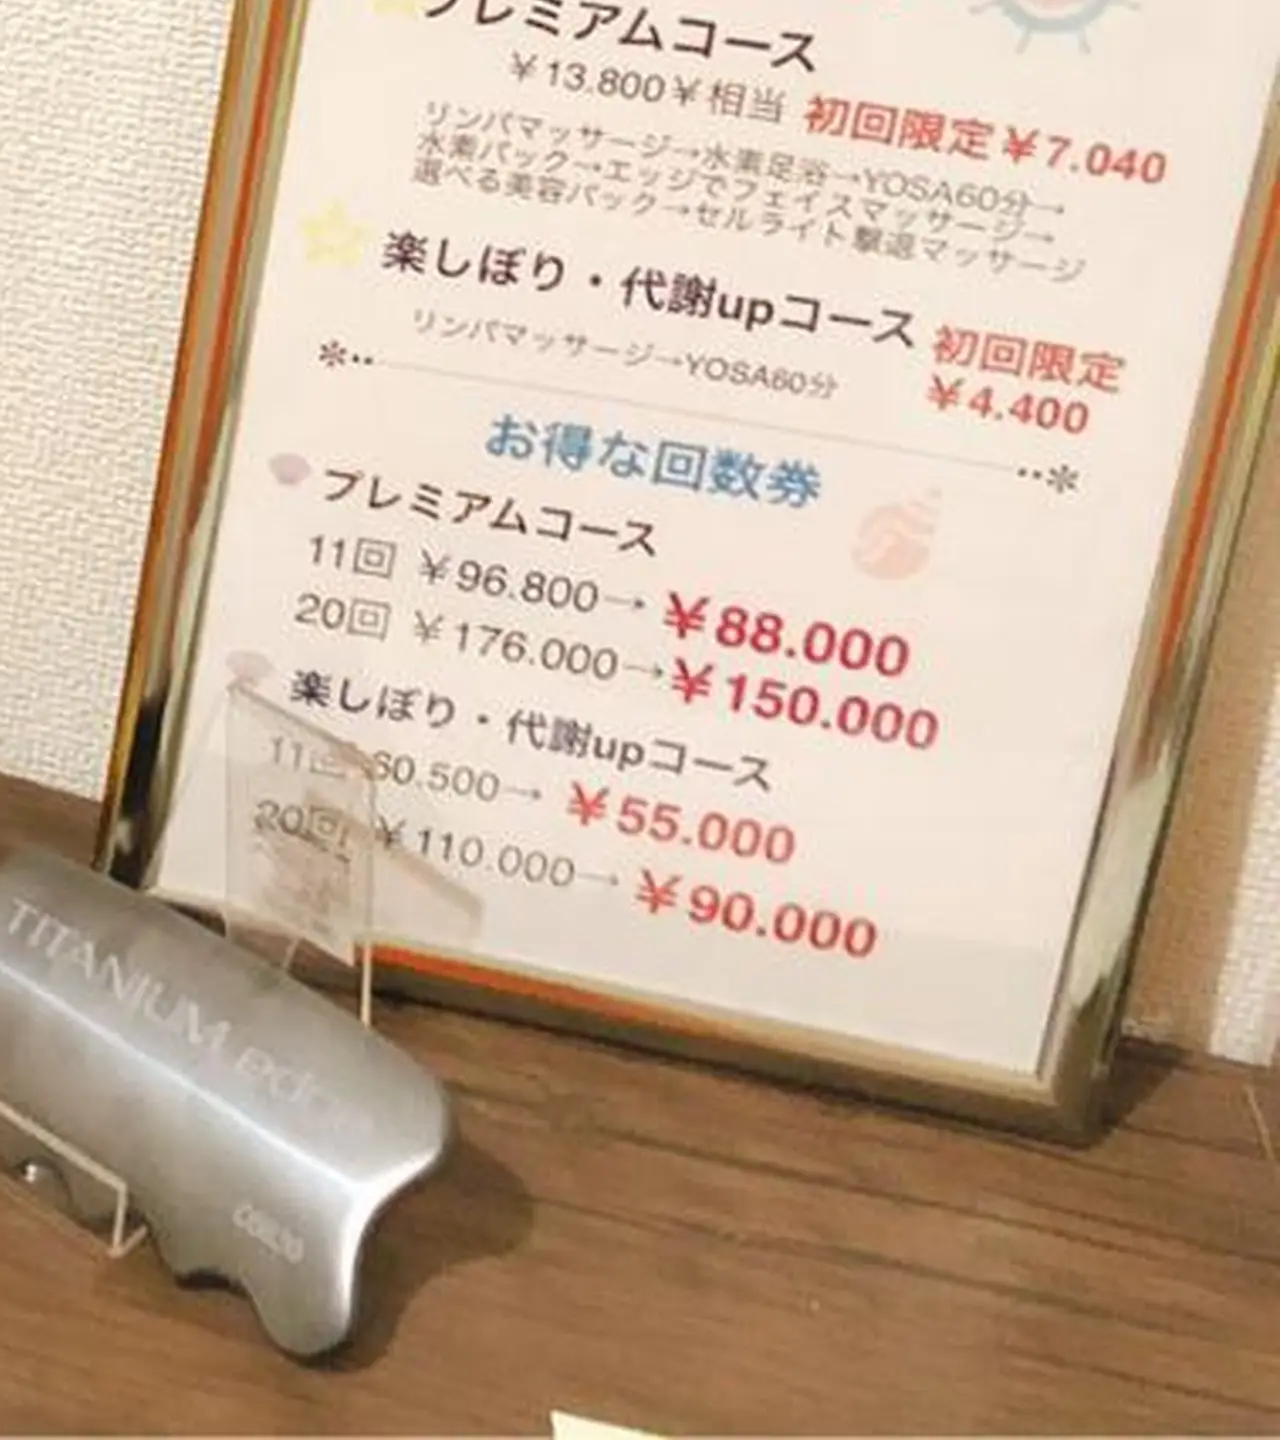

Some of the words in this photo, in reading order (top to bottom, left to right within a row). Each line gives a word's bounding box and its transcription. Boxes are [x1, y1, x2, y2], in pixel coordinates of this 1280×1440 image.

[803, 94, 1167, 184] 初回限定¥7.040
[382, 230, 915, 349] 楽しぼり・代謝upコース
[932, 324, 1127, 394] 初回限定
[926, 372, 1090, 435] ¥4.400
[485, 413, 822, 509] お得な回数券
[323, 466, 659, 558] プレミアムコース
[308, 533, 398, 581] 11回
[663, 590, 911, 678] ¥88.000
[294, 591, 392, 643] 20回
[670, 657, 940, 751] ¥150.000
[289, 668, 773, 793] 楽しぼり・代謝upコース
[566, 780, 796, 863] ¥55.000
[634, 867, 878, 958] ¥90.000
[6, 896, 232, 1050] TITANIUM
